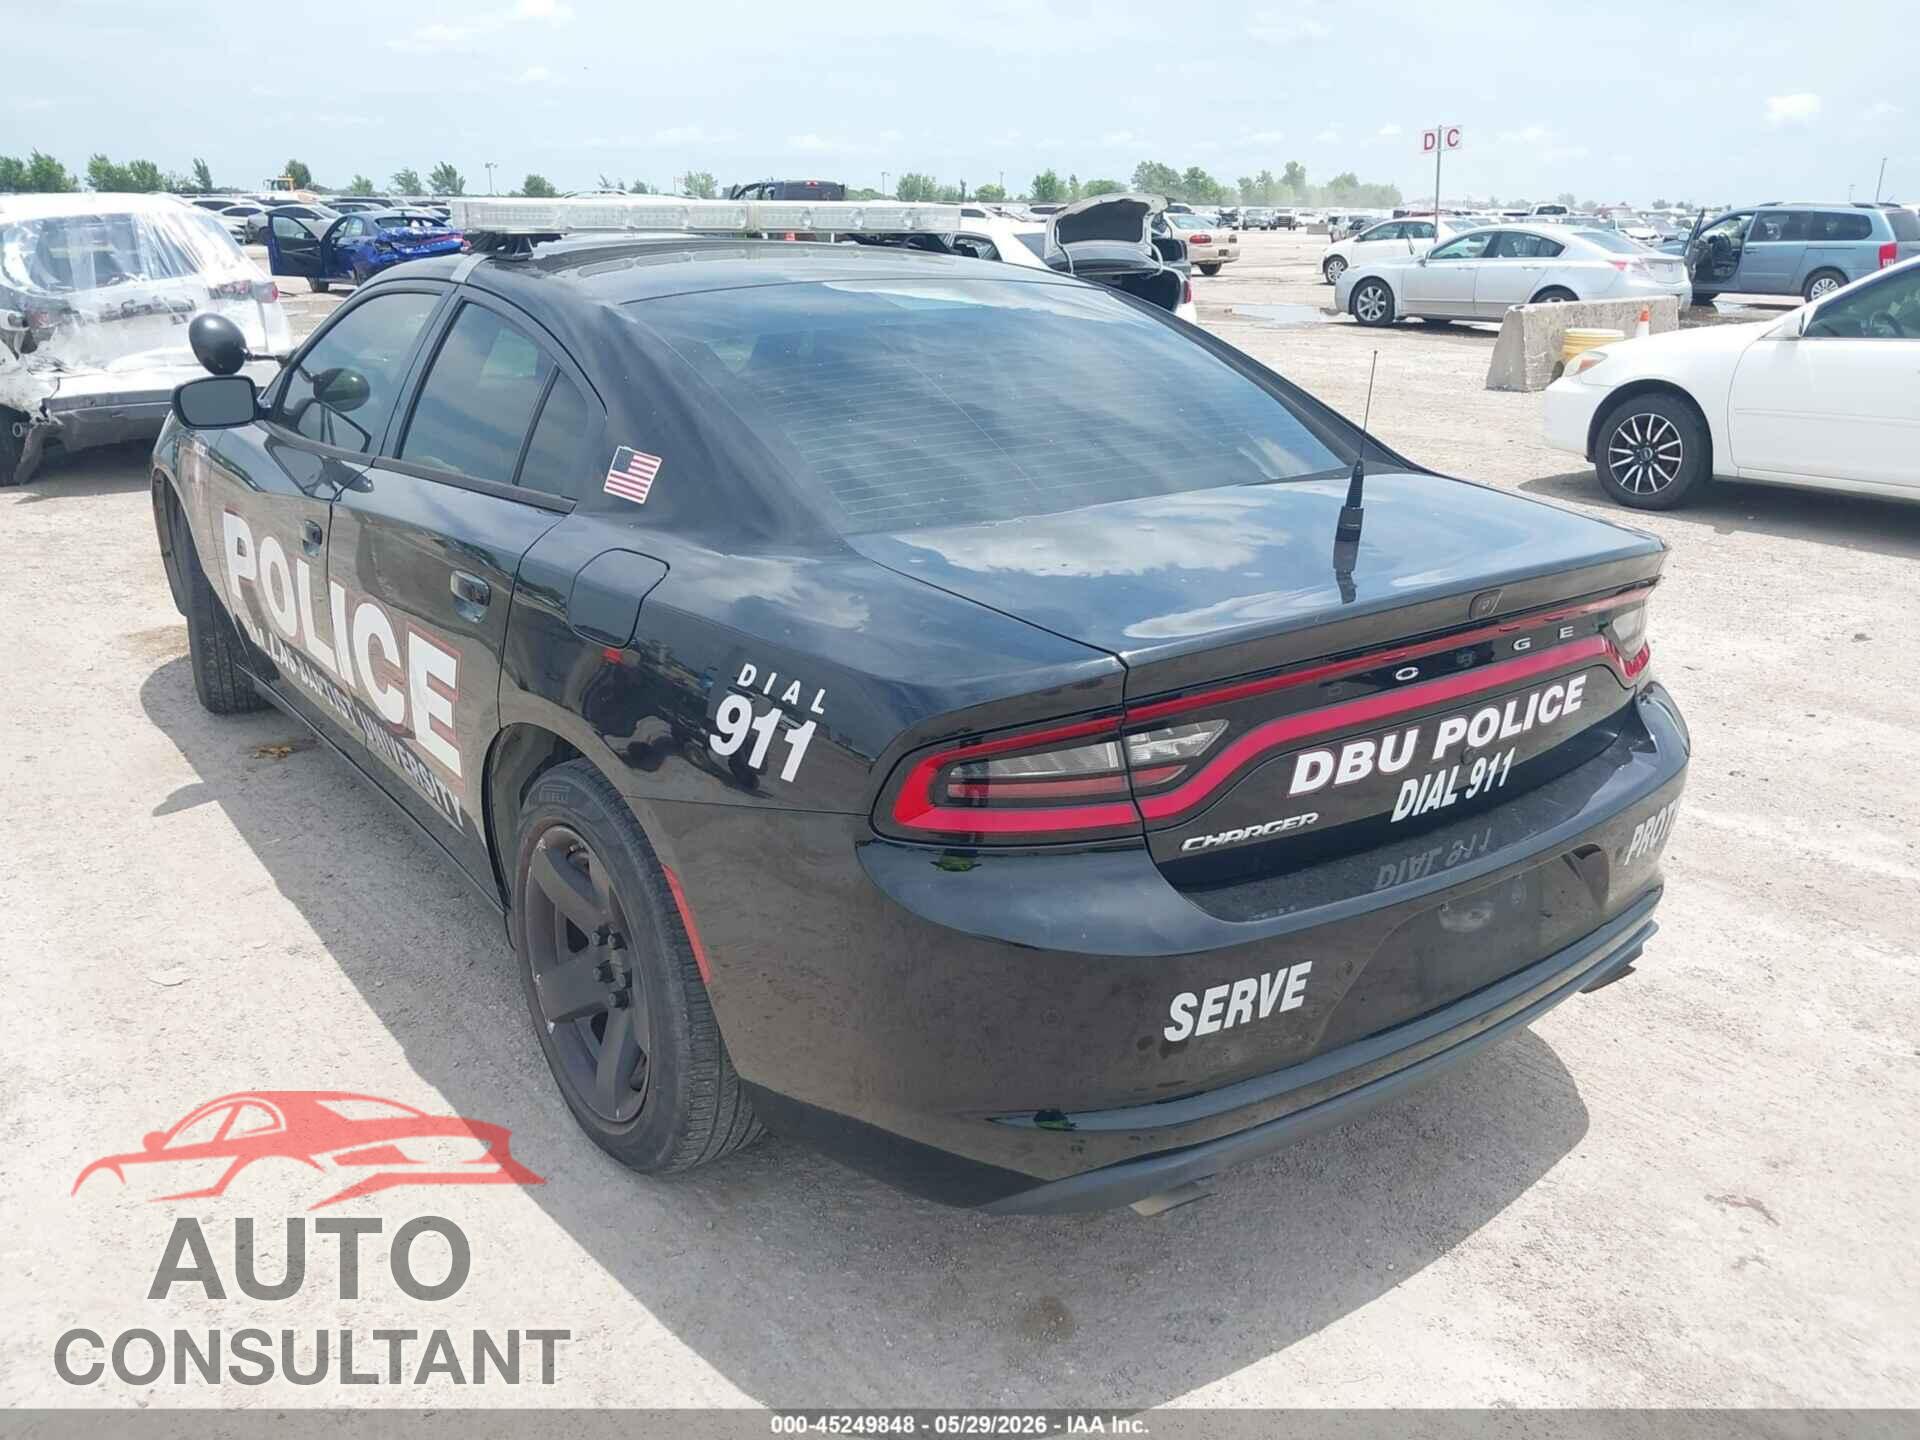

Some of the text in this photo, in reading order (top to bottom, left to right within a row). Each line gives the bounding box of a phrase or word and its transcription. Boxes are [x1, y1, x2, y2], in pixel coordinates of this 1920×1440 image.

[1423, 128, 1460, 151] D C
[223, 509, 464, 778] POLICE
[736, 662, 827, 715] DIAL
[356, 705, 464, 827] UNIVERSITY
[709, 694, 817, 783] 911
[1289, 674, 1588, 796] DBU POLICE
[1390, 747, 1515, 824] DIAL 911
[1181, 811, 1320, 852] CHARGER
[1163, 960, 1313, 1043] SERVE
